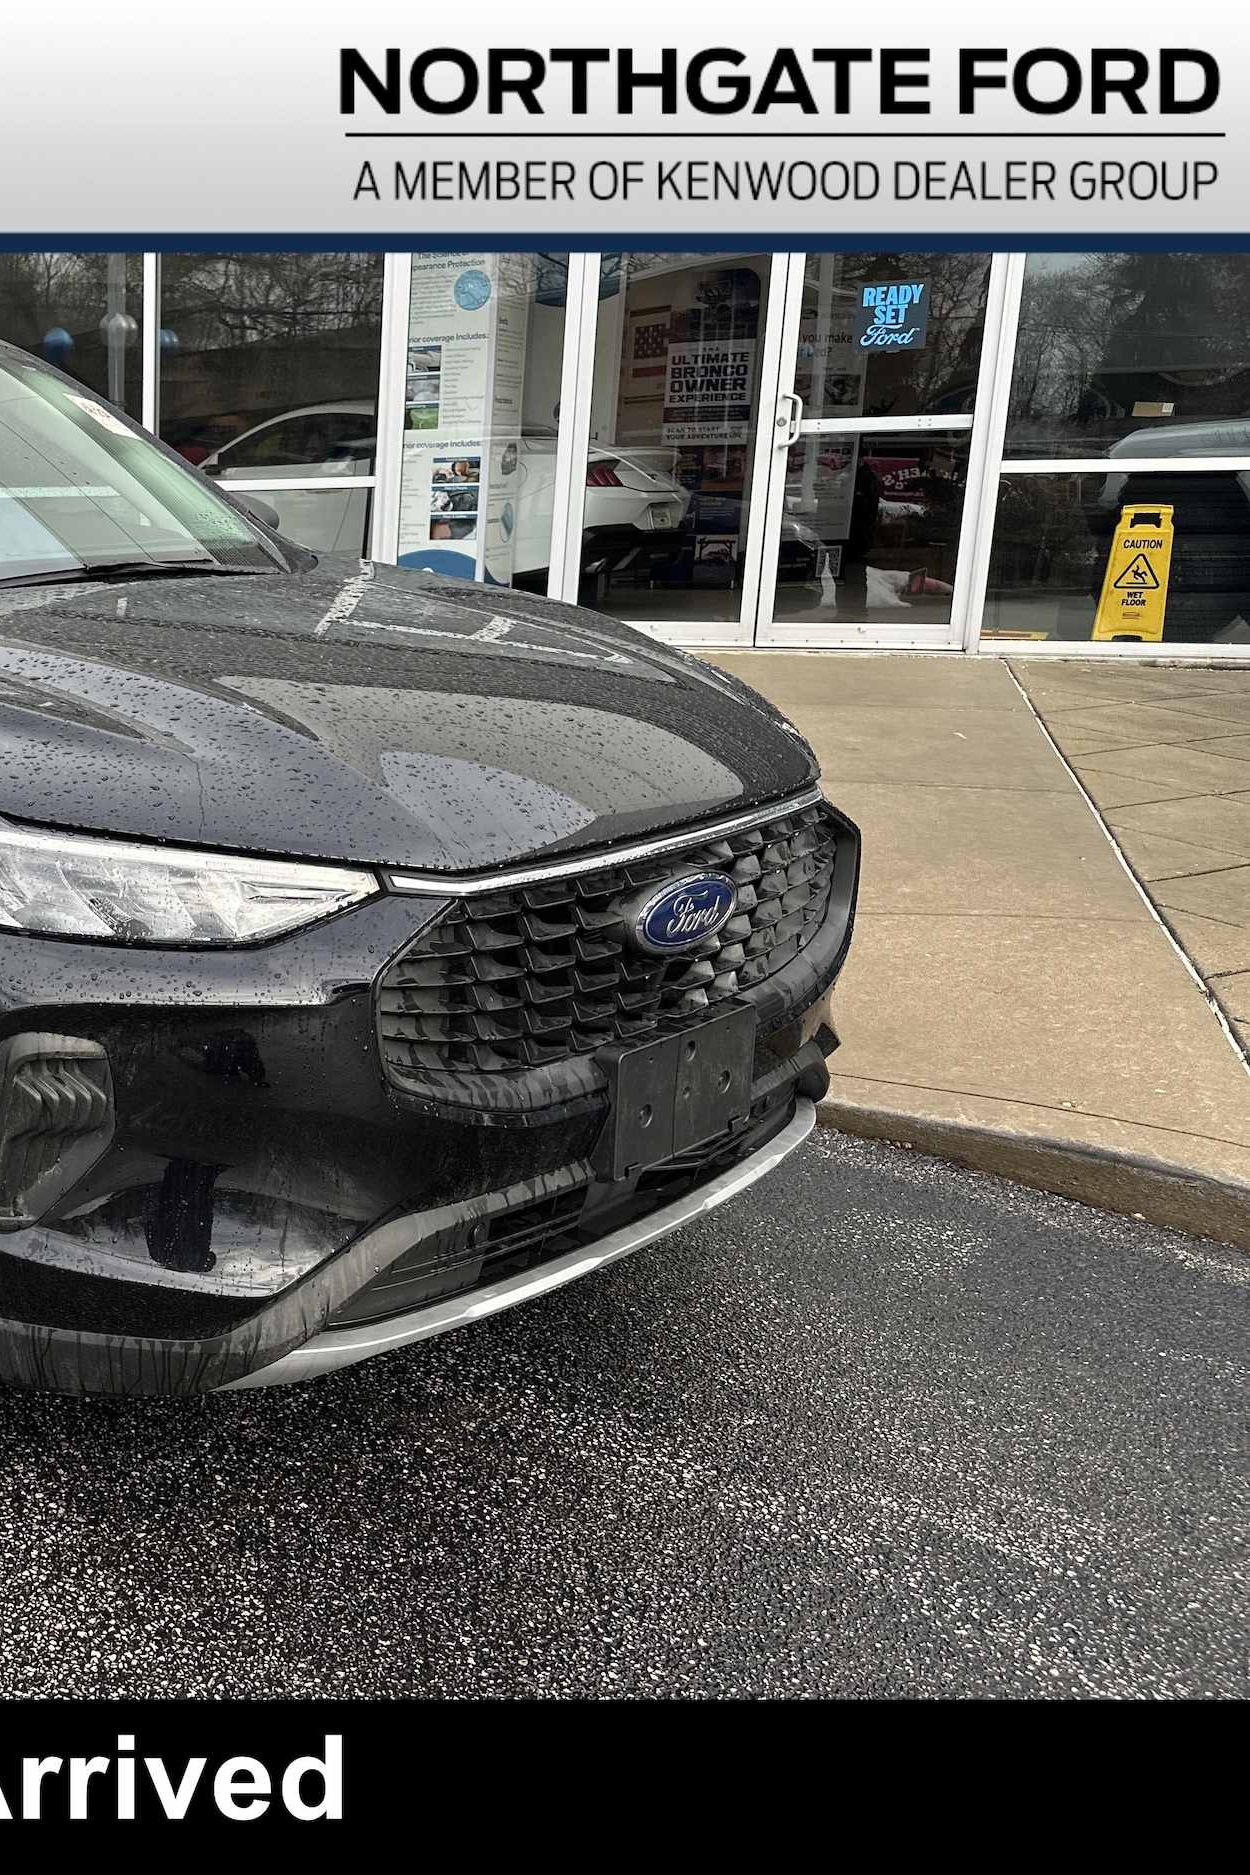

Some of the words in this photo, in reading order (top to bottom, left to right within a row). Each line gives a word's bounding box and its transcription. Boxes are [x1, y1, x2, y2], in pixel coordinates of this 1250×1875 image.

[412, 263, 447, 273] pearance
[448, 260, 486, 269] Protection
[863, 284, 924, 307] READY
[873, 304, 908, 324] SET
[422, 335, 455, 343] coverage
[802, 334, 821, 343] you
[826, 332, 853, 344] make
[860, 324, 916, 346] Ford
[671, 352, 750, 366] ULTIMATE
[671, 364, 748, 379] BRONCO
[670, 377, 747, 393] OWNER
[669, 392, 746, 403] EXPERIENCE
[416, 441, 450, 450] coverage
[1123, 540, 1163, 549] CAUTION
[1127, 591, 1144, 599] WET
[666, 890, 721, 938] Ford
